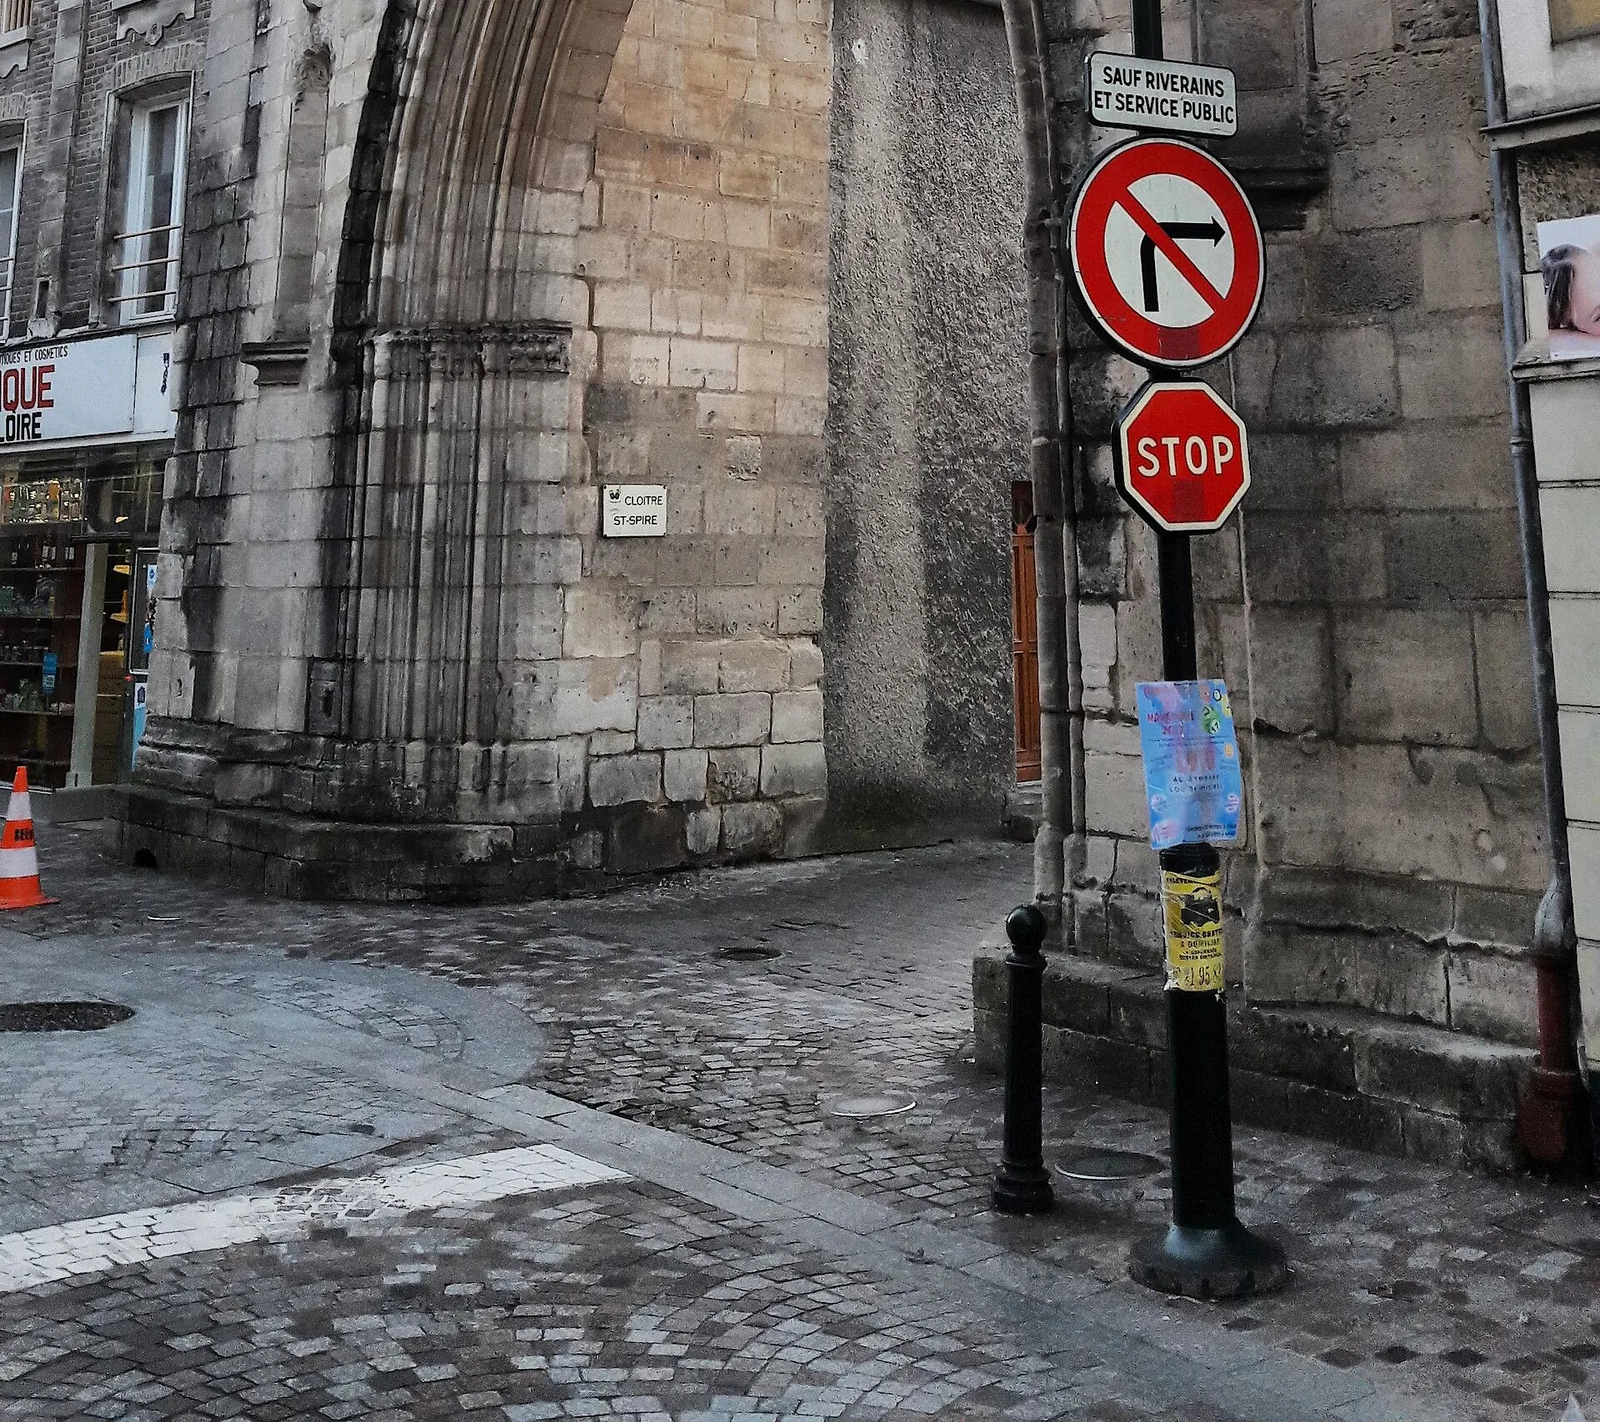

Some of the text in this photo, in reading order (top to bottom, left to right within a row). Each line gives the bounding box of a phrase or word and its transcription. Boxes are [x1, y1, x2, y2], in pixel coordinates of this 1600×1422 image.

[1103, 66, 1225, 98] SAUF RIVERAINS
[1094, 90, 1234, 124] ET SERVICE PUBLIC
[24, 350, 31, 363] ET
[35, 345, 68, 361] COSMETICS
[0, 364, 55, 414] QUE
[1137, 435, 1234, 477] STOP
[624, 496, 663, 505] CLOITRE
